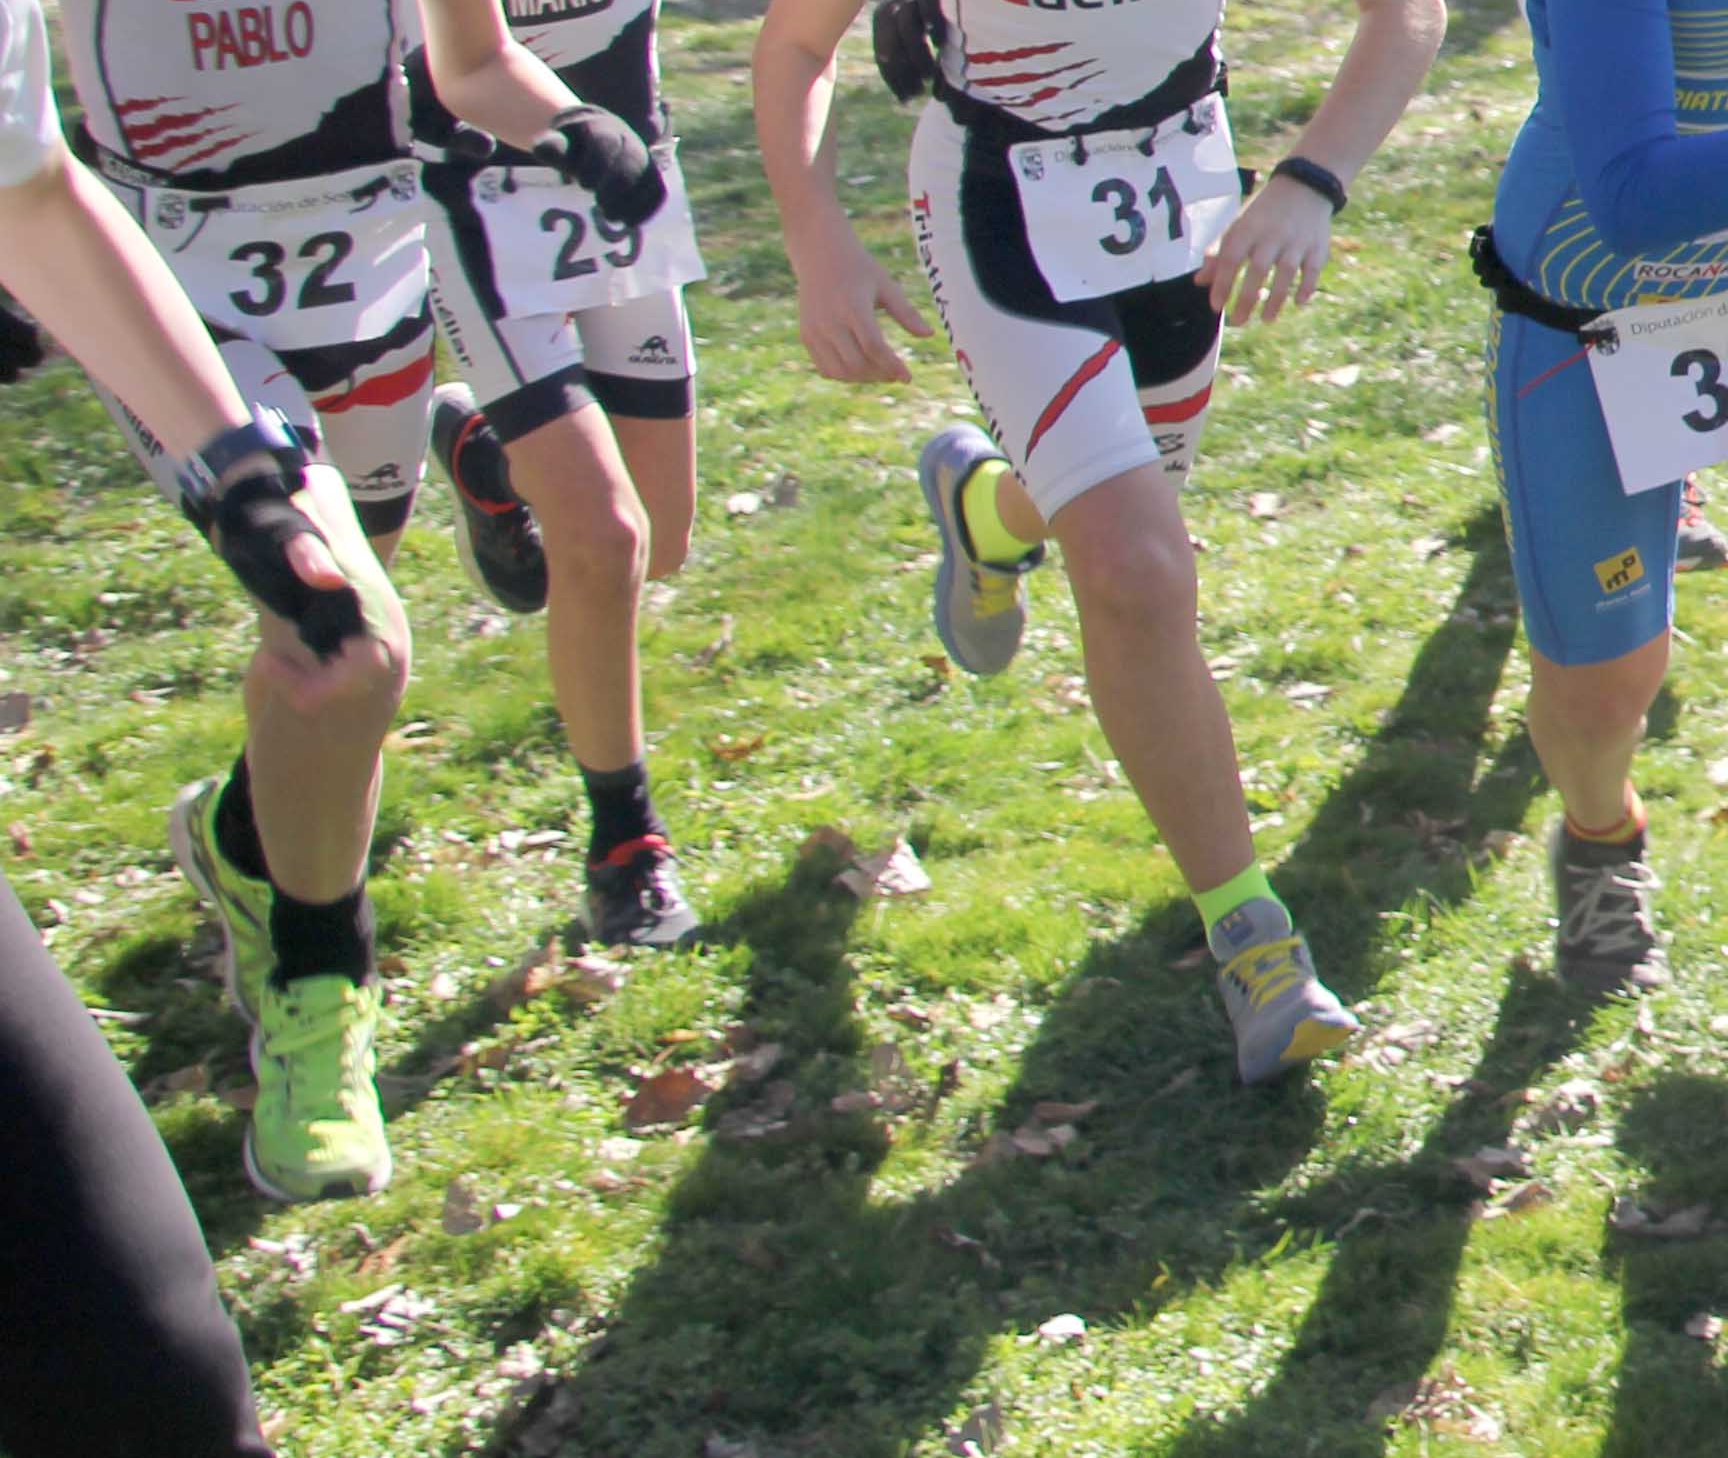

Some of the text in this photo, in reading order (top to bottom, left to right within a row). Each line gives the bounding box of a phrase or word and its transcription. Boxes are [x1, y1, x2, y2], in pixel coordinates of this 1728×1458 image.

[187, 0, 315, 71] PABLO
[540, 207, 643, 281] 29
[1091, 165, 1184, 256] 31
[228, 230, 356, 317] 32
[1629, 306, 1714, 336] Diputación
